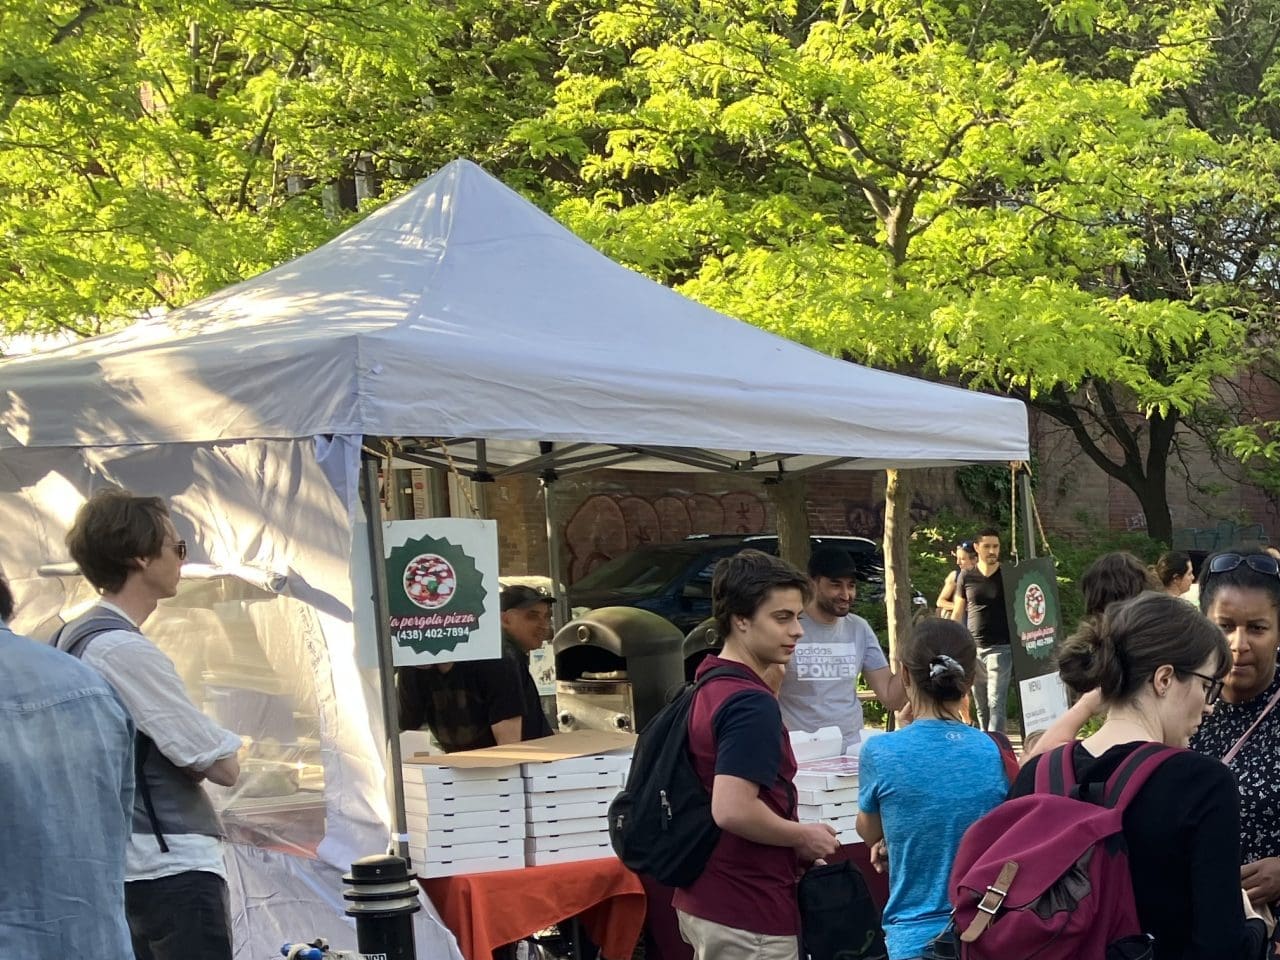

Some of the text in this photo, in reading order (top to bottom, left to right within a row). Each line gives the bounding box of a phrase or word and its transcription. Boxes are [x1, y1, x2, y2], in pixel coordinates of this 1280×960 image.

[399, 613, 443, 630] pergola
[443, 612, 475, 627] pizza
[396, 629, 422, 642] (438)
[796, 646, 833, 656] adidas
[796, 655, 856, 665] UNEXPECTED
[797, 663, 857, 678] POWER
